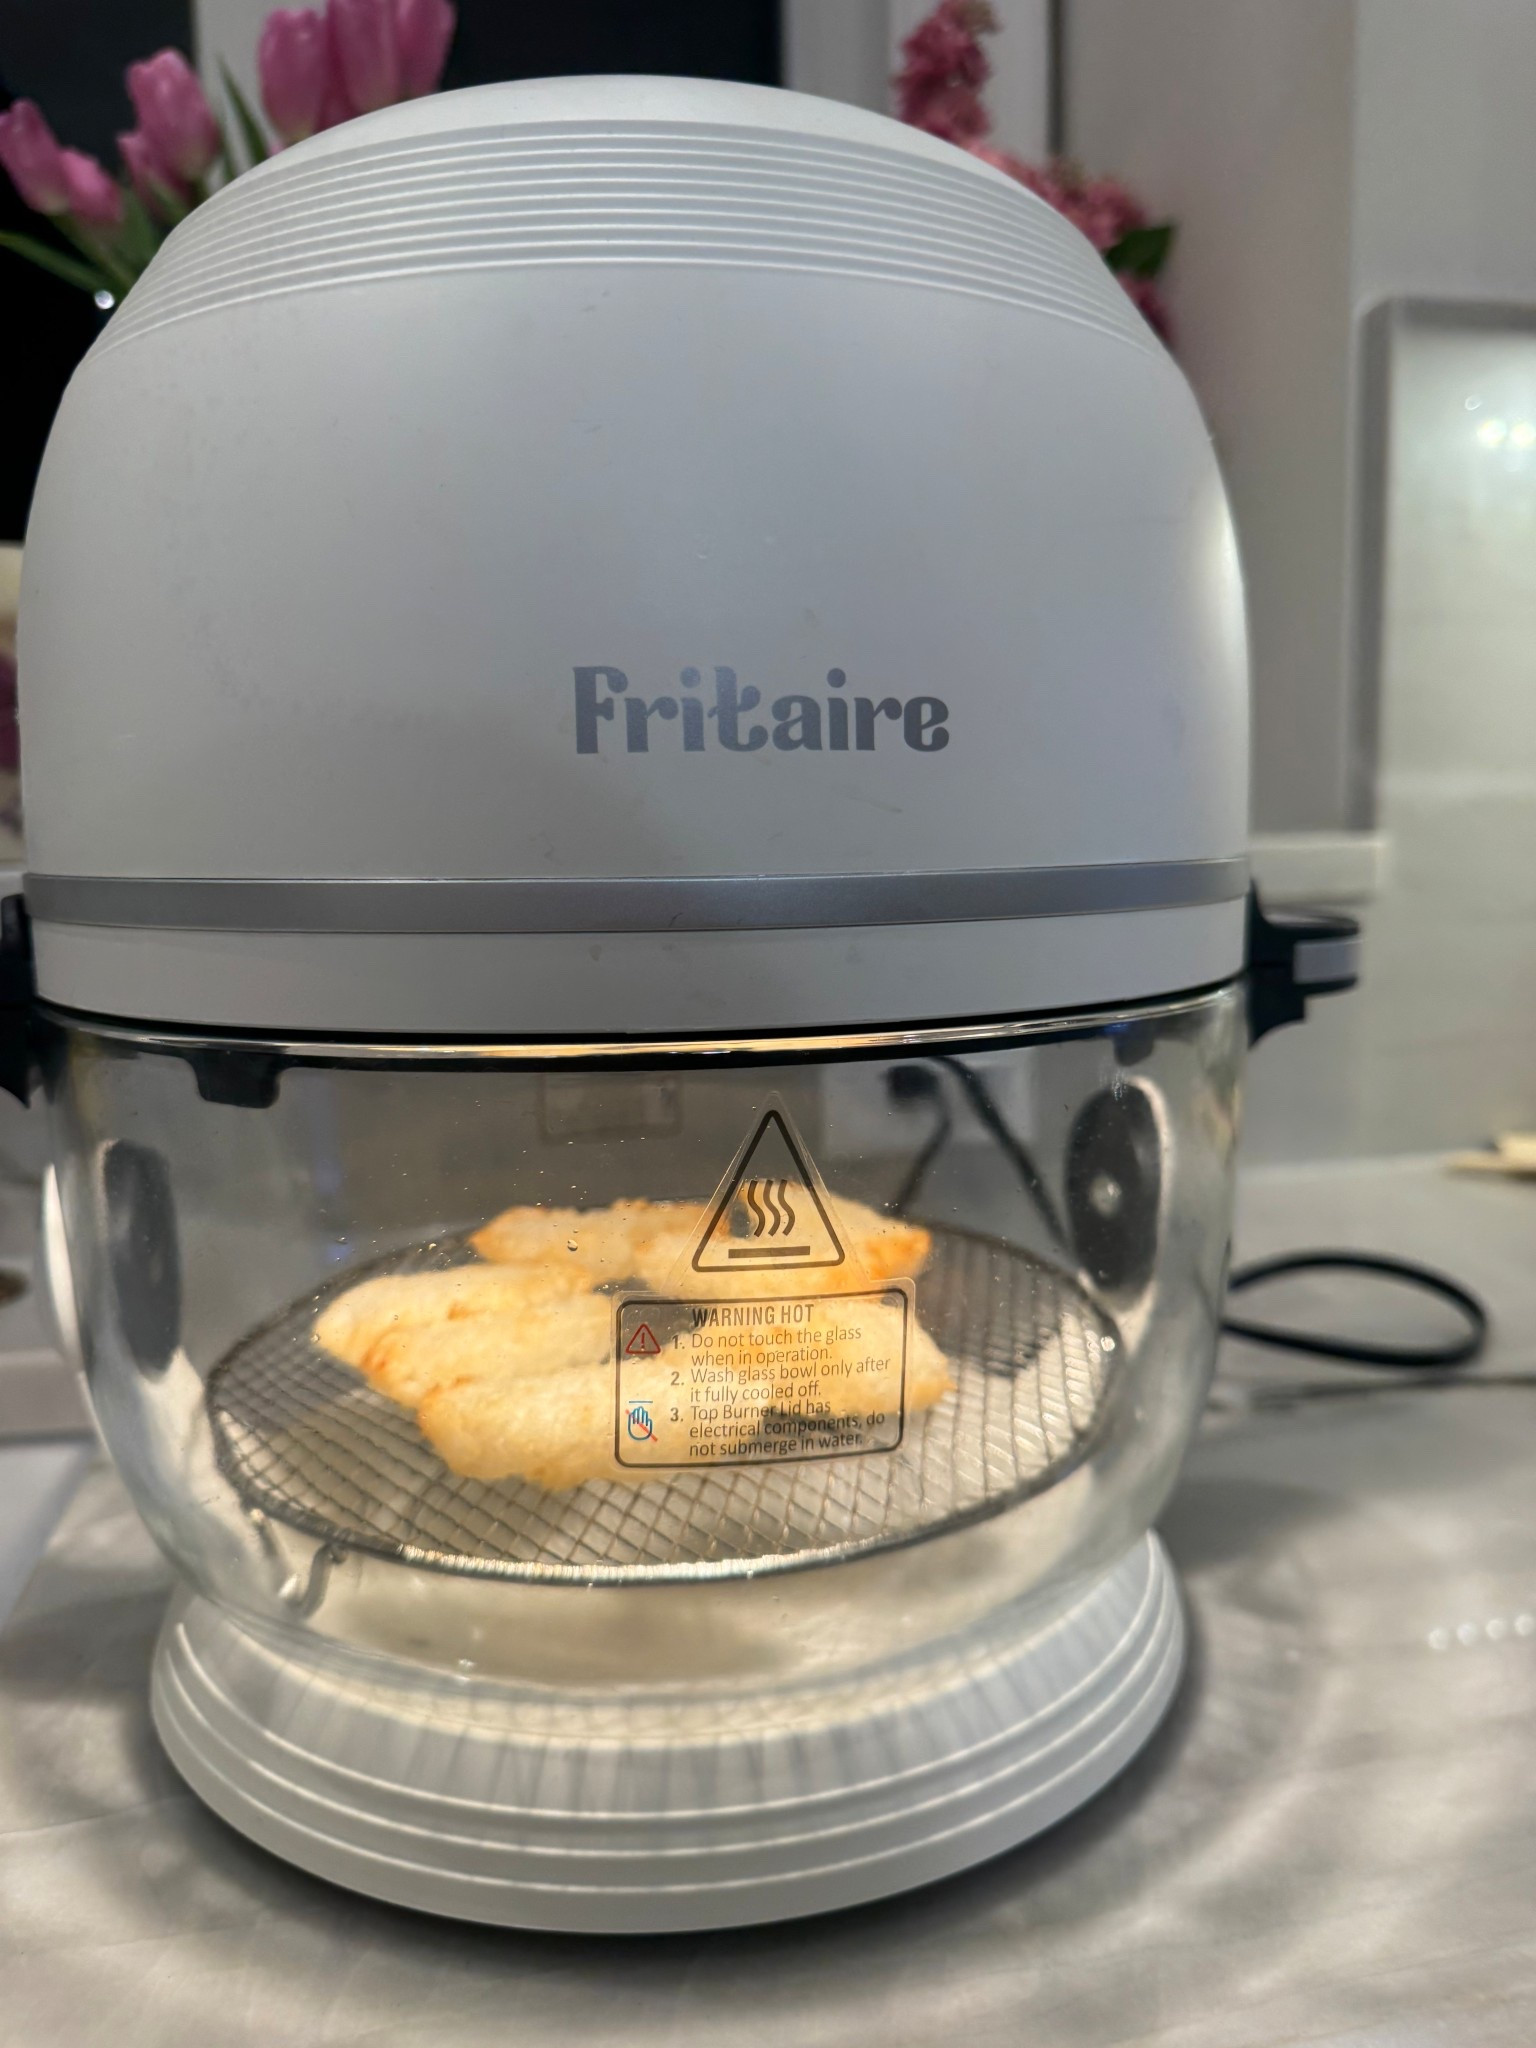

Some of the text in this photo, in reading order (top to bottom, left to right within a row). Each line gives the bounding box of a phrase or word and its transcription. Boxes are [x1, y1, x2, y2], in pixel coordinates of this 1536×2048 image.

[573, 666, 950, 754] Fritaire
[692, 1303, 814, 1327] WARNING HOT
[672, 1325, 861, 1349] 1. Do not touch the glass
[691, 1346, 832, 1367] when in operation.
[670, 1356, 891, 1386] 2. Wash glass bowl only after
[690, 1380, 821, 1404] it fully cooled off.
[670, 1399, 831, 1423] 3. Top Burner Lid has
[689, 1410, 885, 1438] electrical components, do
[690, 1432, 862, 1457] not submerge in water.
